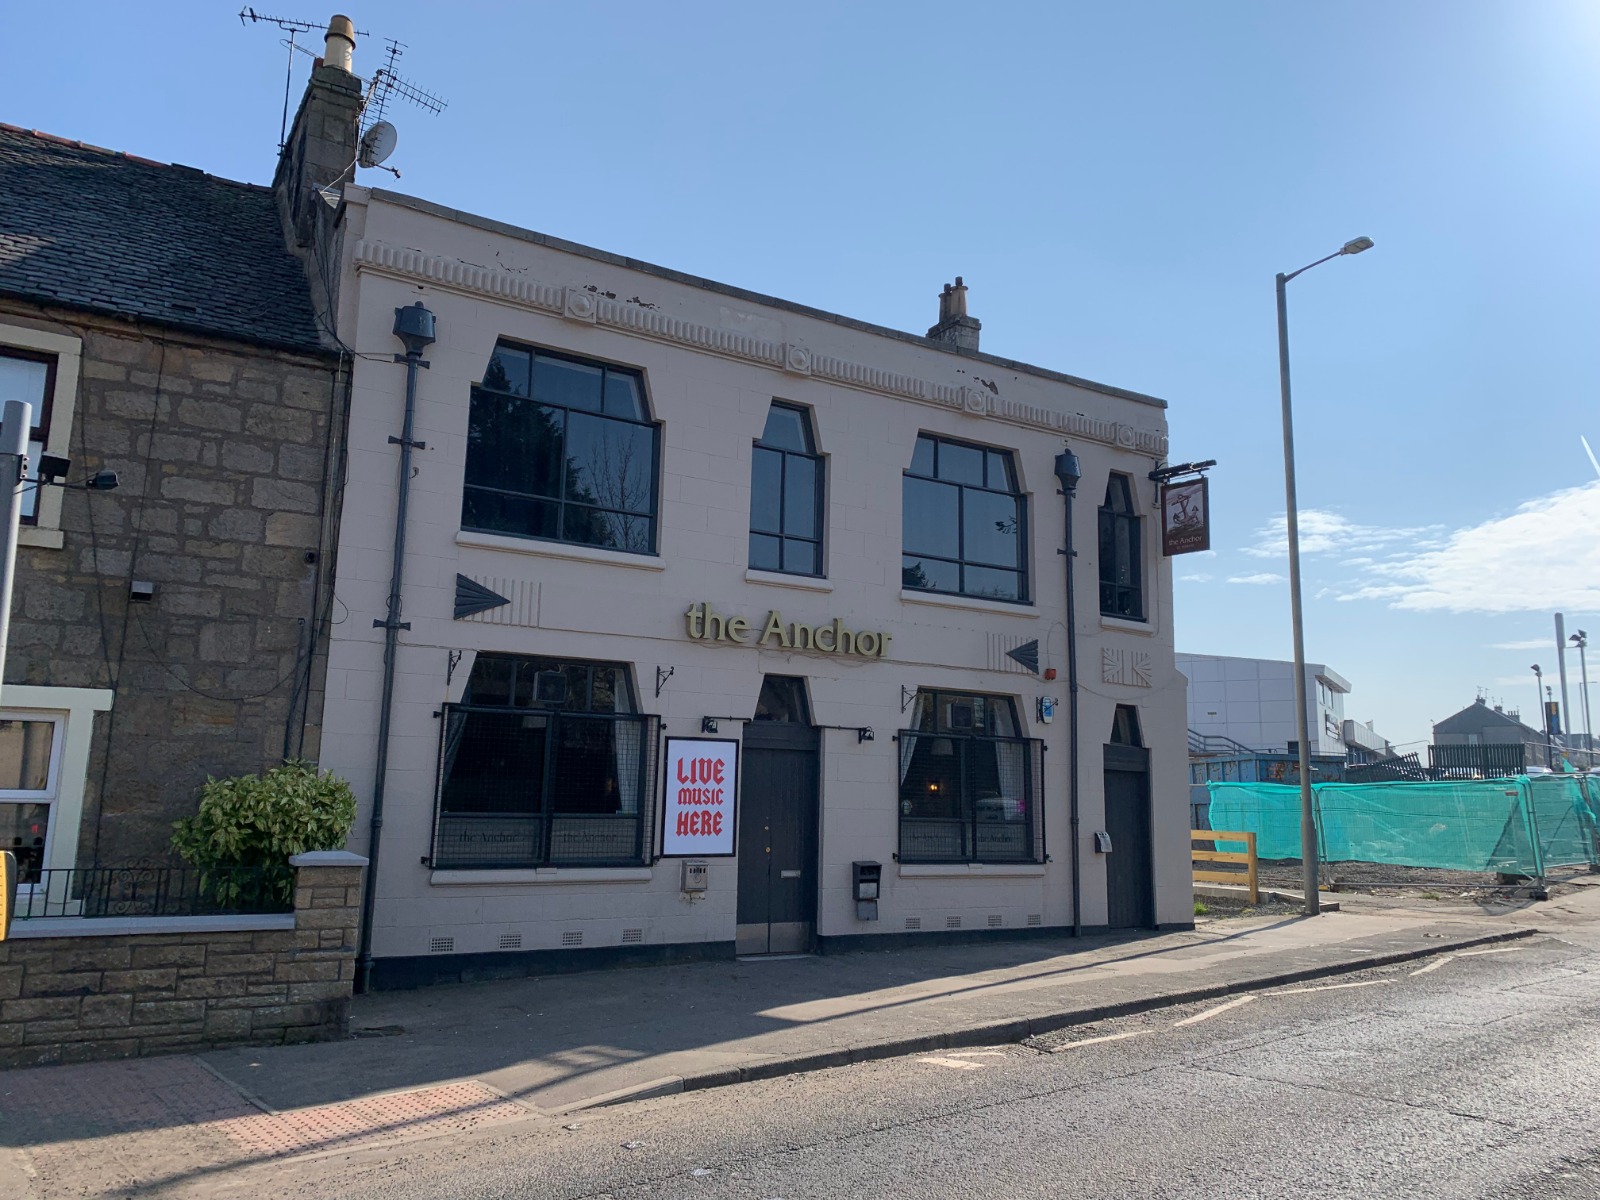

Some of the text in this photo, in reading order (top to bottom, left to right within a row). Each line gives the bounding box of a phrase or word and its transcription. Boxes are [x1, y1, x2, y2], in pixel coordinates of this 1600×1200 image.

[1180, 535, 1202, 544] Anchor
[686, 602, 892, 657] the Anchor
[676, 757, 725, 785] LIVE
[677, 787, 724, 806] MUSIC
[676, 810, 723, 837] HERE
